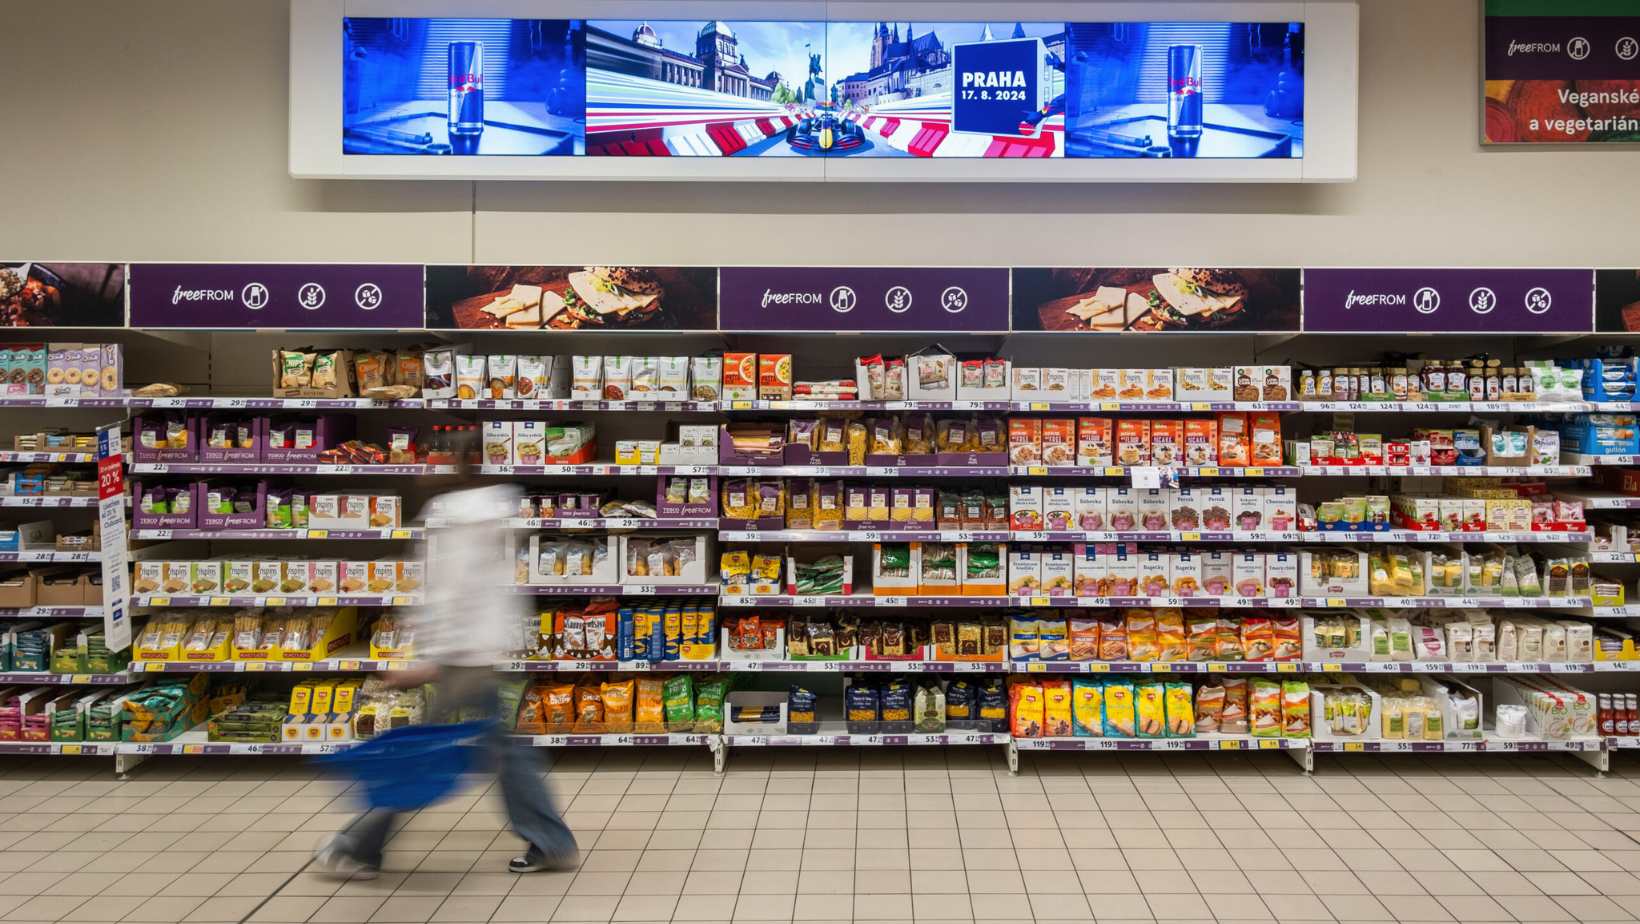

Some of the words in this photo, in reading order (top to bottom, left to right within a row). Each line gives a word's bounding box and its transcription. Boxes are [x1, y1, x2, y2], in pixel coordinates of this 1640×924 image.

[1507, 39, 1561, 56] freeFROM
[962, 70, 1027, 87] PRAHA
[961, 90, 978, 100] 17.
[980, 90, 992, 100] 8.
[995, 90, 1027, 101] 2024
[1557, 88, 1640, 107] Veganské
[1529, 118, 1540, 131] a
[172, 285, 234, 305] freeFROM
[761, 288, 822, 308] freeFROM
[1345, 290, 1406, 309] freeFROM
